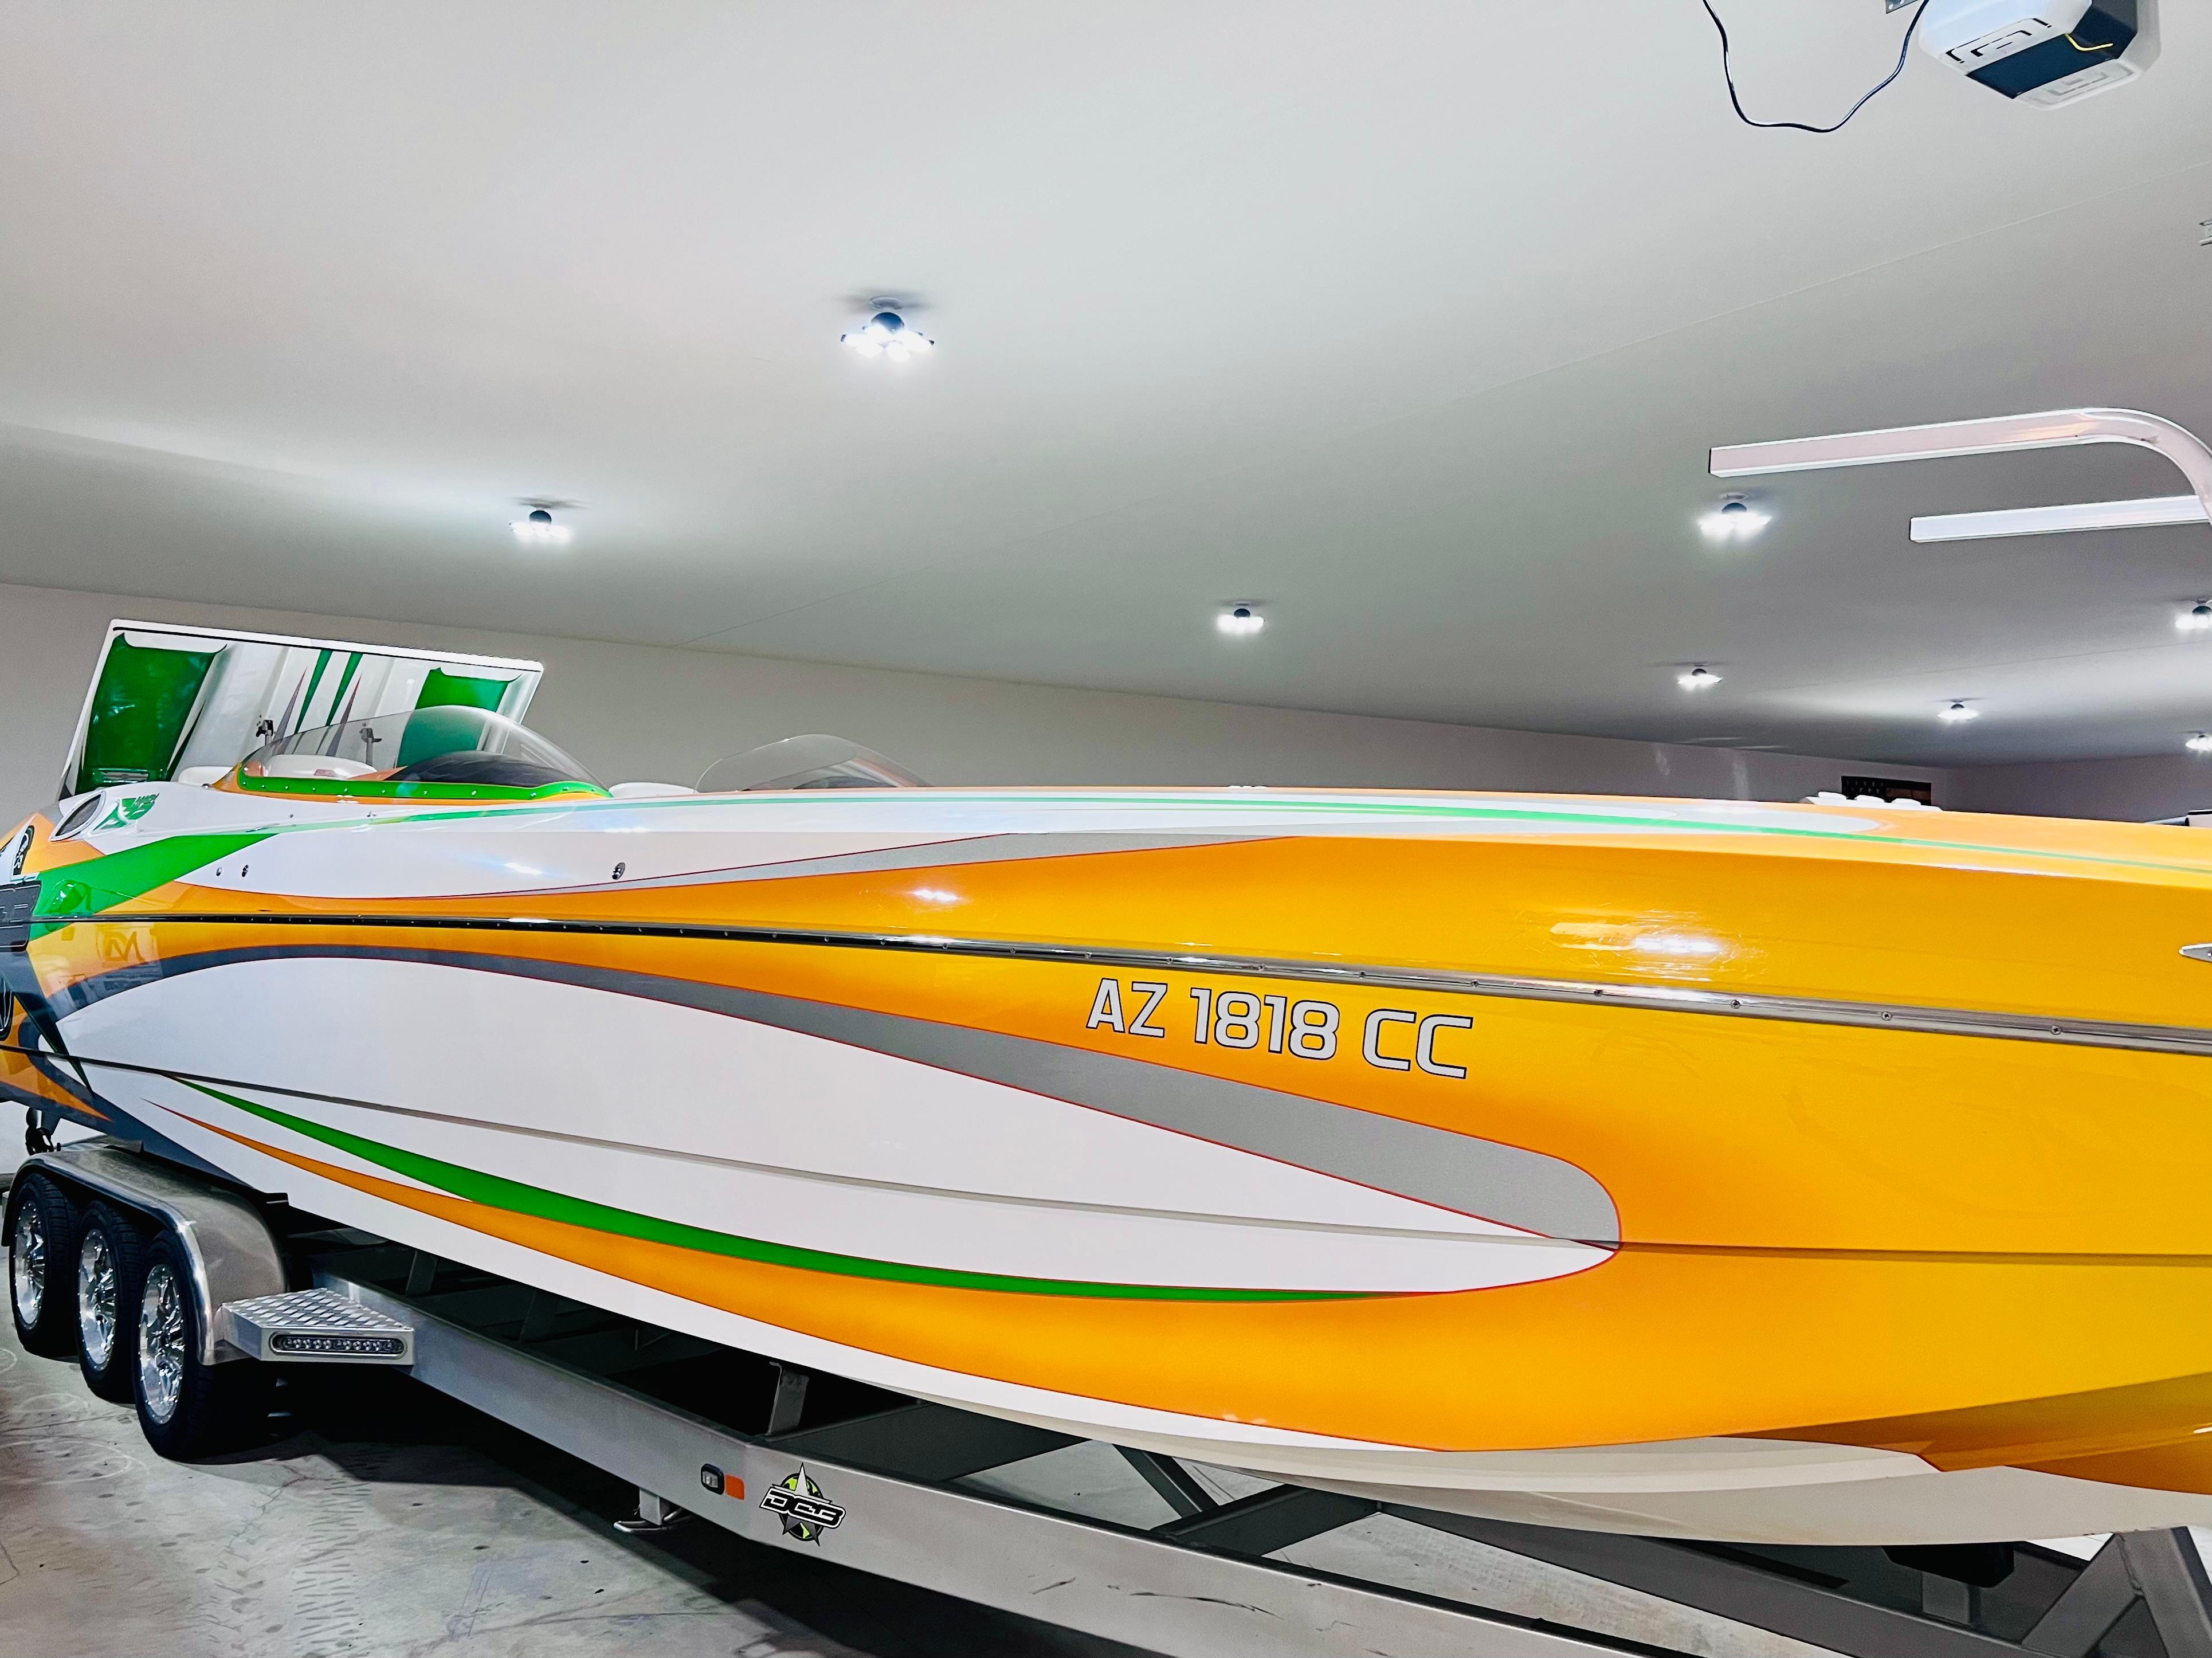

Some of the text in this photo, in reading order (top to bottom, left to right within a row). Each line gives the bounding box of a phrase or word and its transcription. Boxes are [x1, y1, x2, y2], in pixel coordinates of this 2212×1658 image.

[1085, 977, 1473, 1080] AZ 1818 CC
